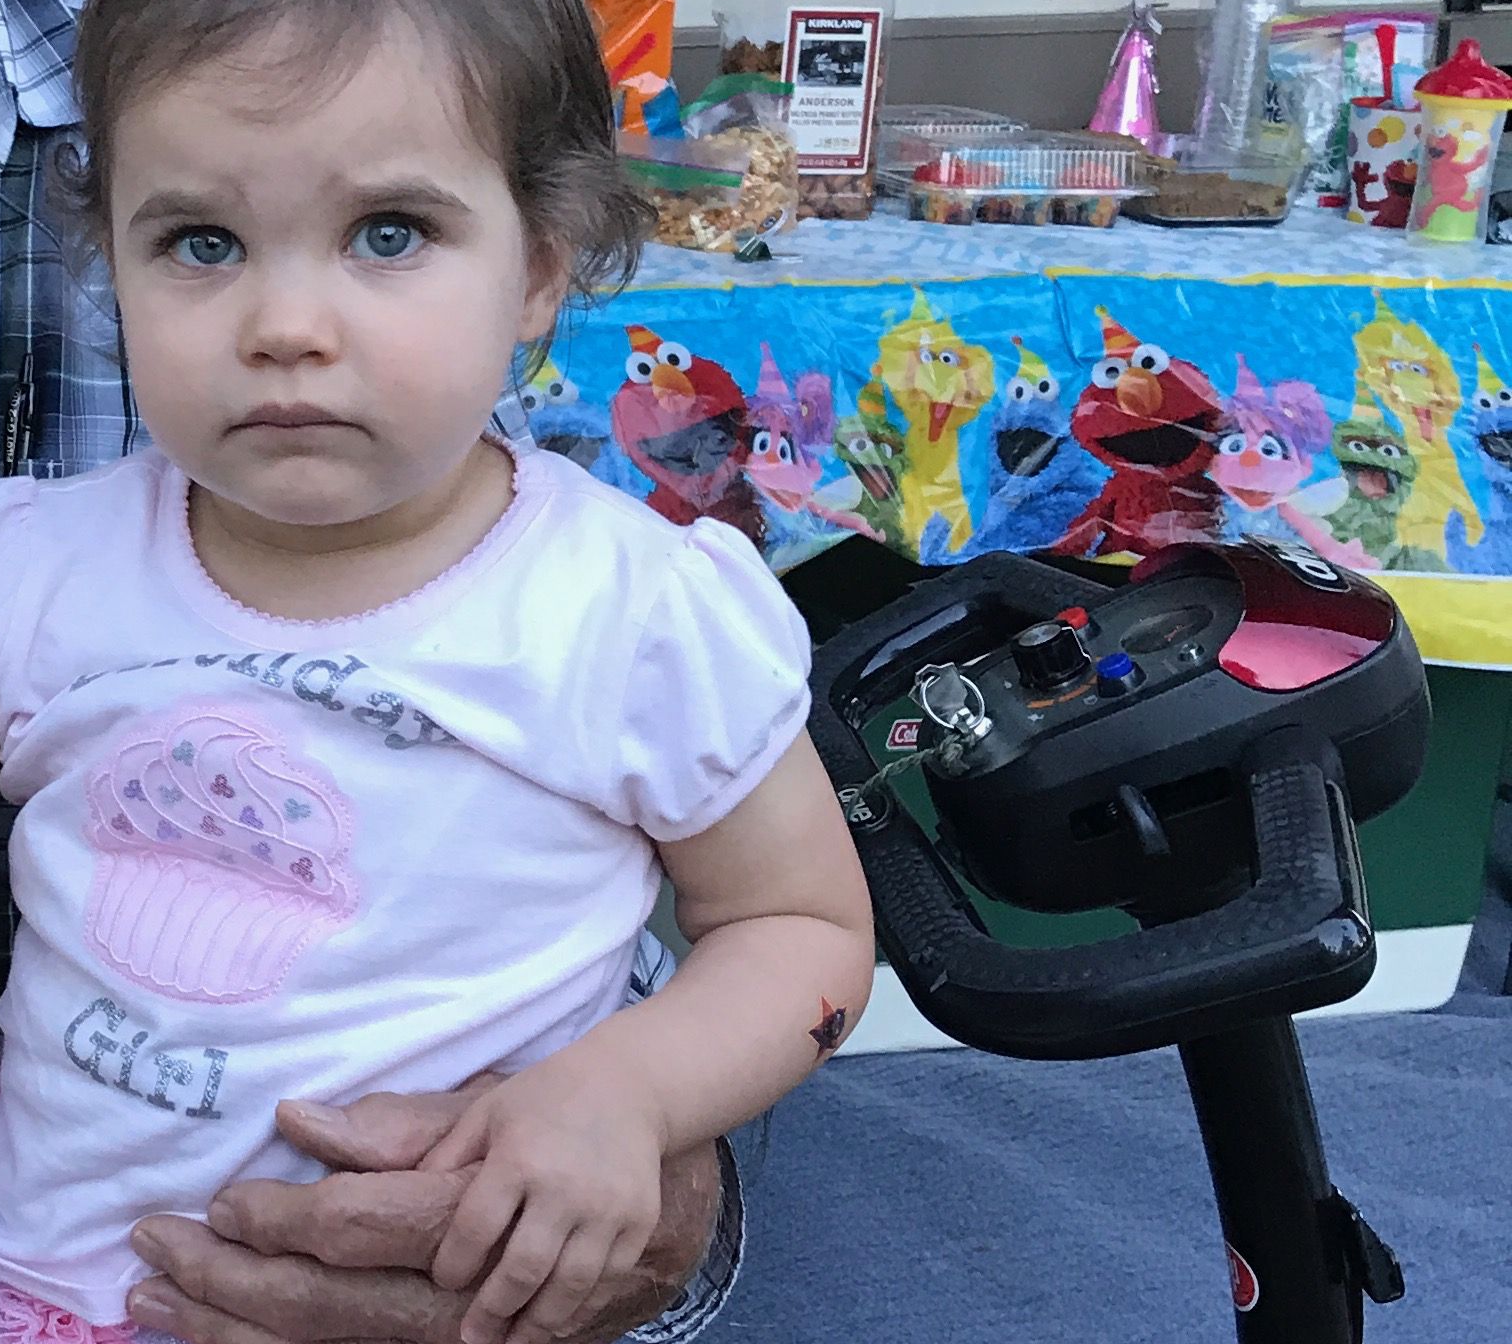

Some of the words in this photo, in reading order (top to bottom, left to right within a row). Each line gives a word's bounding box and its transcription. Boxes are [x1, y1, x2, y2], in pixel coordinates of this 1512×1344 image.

[808, 19, 863, 29] KIRKLAND
[799, 97, 855, 106] ANDERSON
[64, 997, 228, 1119] Girl
